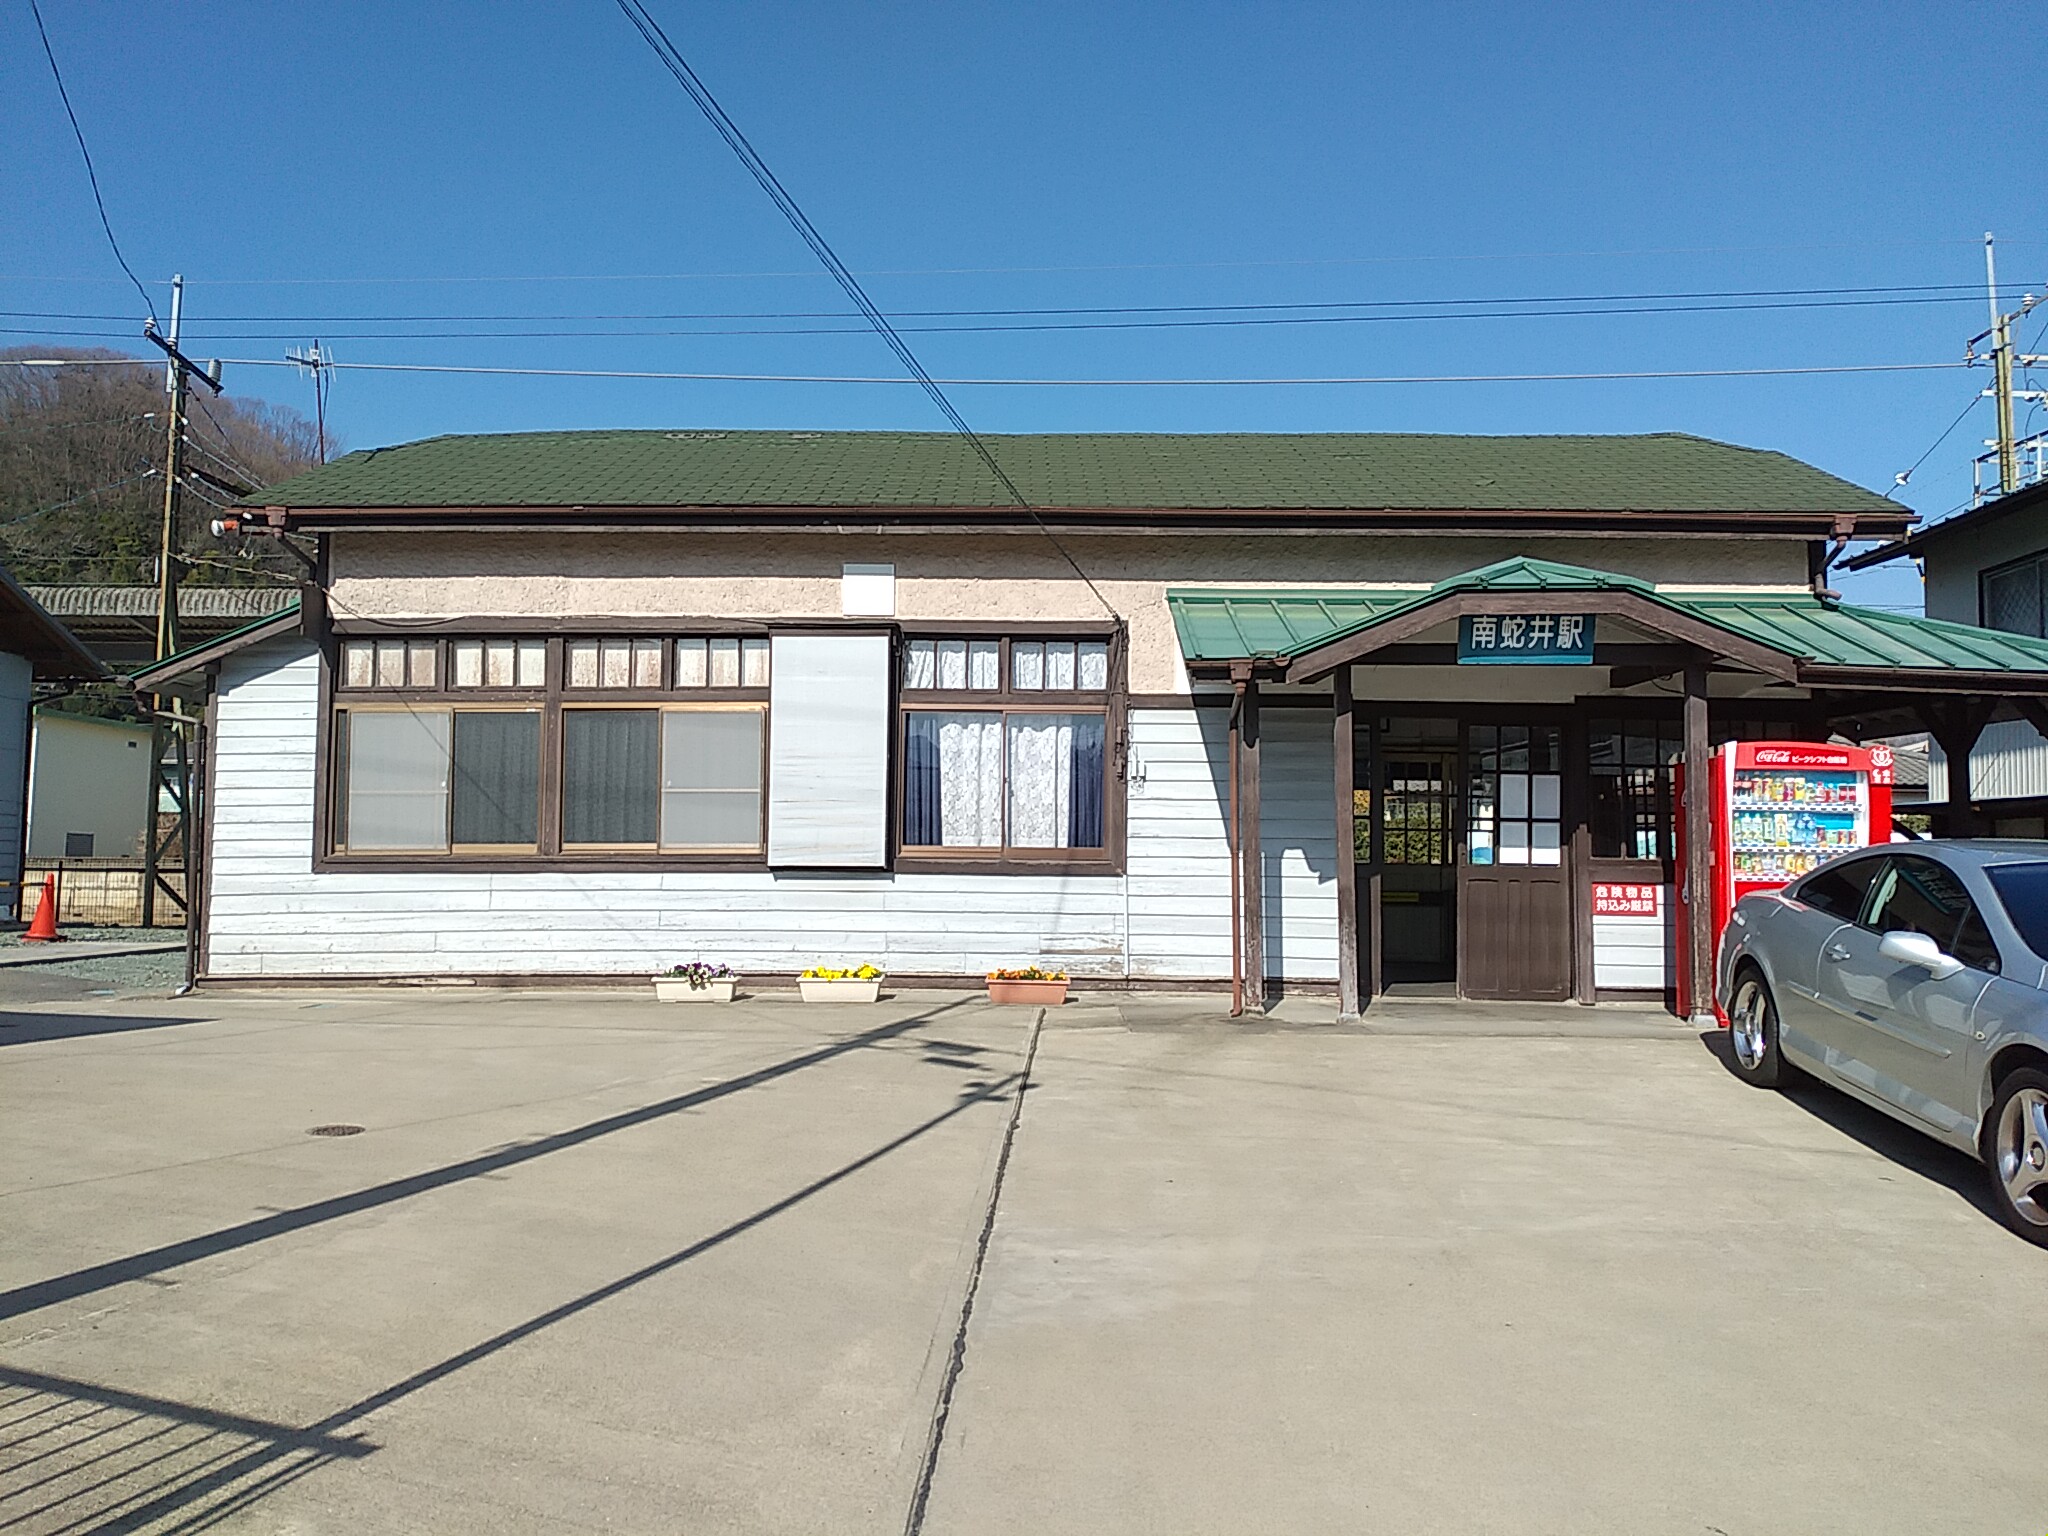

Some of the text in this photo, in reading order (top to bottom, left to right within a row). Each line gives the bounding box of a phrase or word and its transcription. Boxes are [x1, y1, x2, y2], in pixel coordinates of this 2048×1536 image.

[1471, 615, 1583, 649] 南蛇井駅
[1595, 886, 1653, 898] 危険物品
